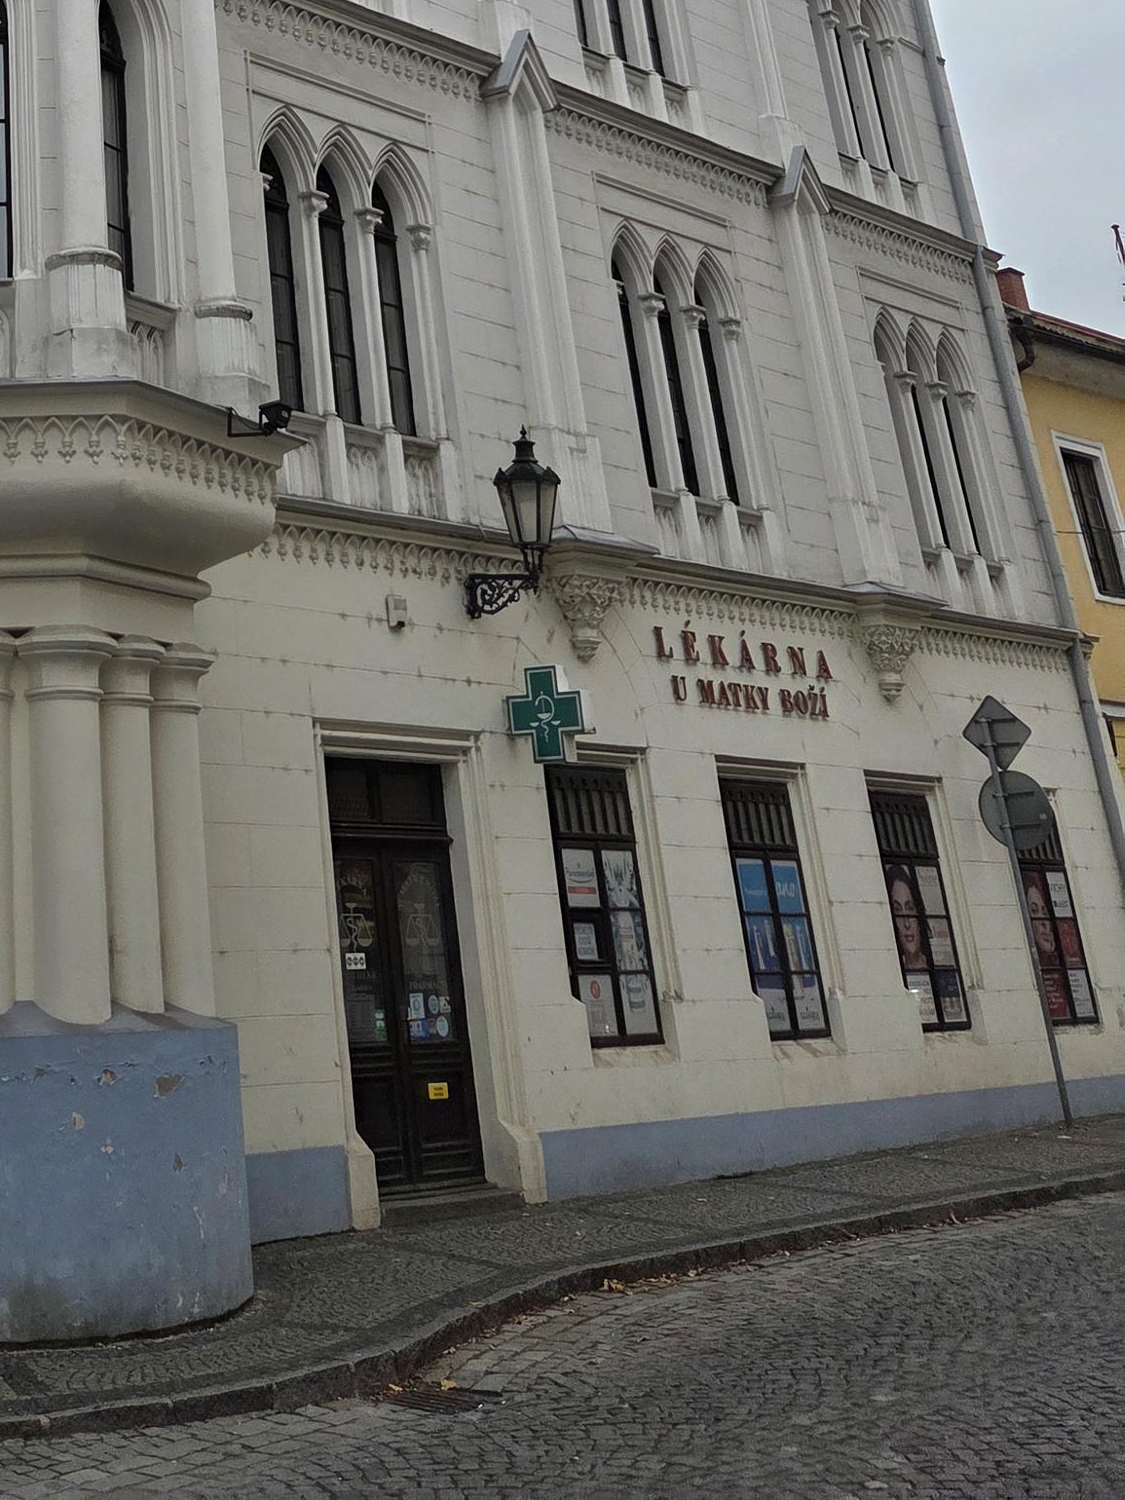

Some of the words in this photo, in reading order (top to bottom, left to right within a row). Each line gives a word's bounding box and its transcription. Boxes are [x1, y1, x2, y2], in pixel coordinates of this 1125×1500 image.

[653, 619, 833, 680] LÉKÁRNA
[671, 675, 687, 702] U
[697, 679, 770, 711] MATKY
[779, 684, 831, 718] BOŽÍ
